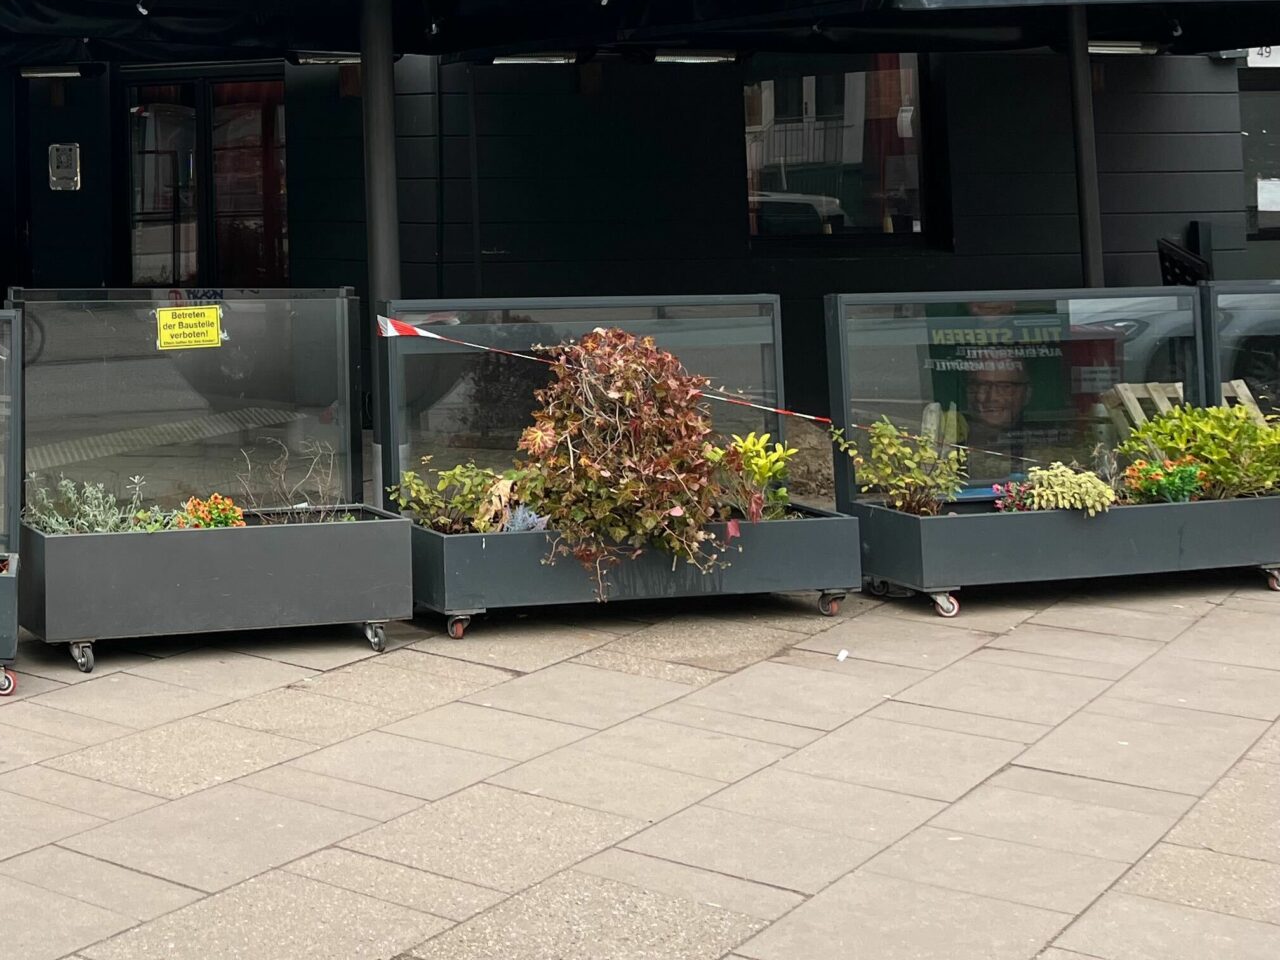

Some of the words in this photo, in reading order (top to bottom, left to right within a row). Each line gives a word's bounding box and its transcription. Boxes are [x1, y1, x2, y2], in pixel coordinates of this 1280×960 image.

[171, 311, 205, 319] Betreten
[162, 322, 176, 330] der
[178, 320, 214, 329] Baustelle
[170, 330, 208, 339] verboten!
